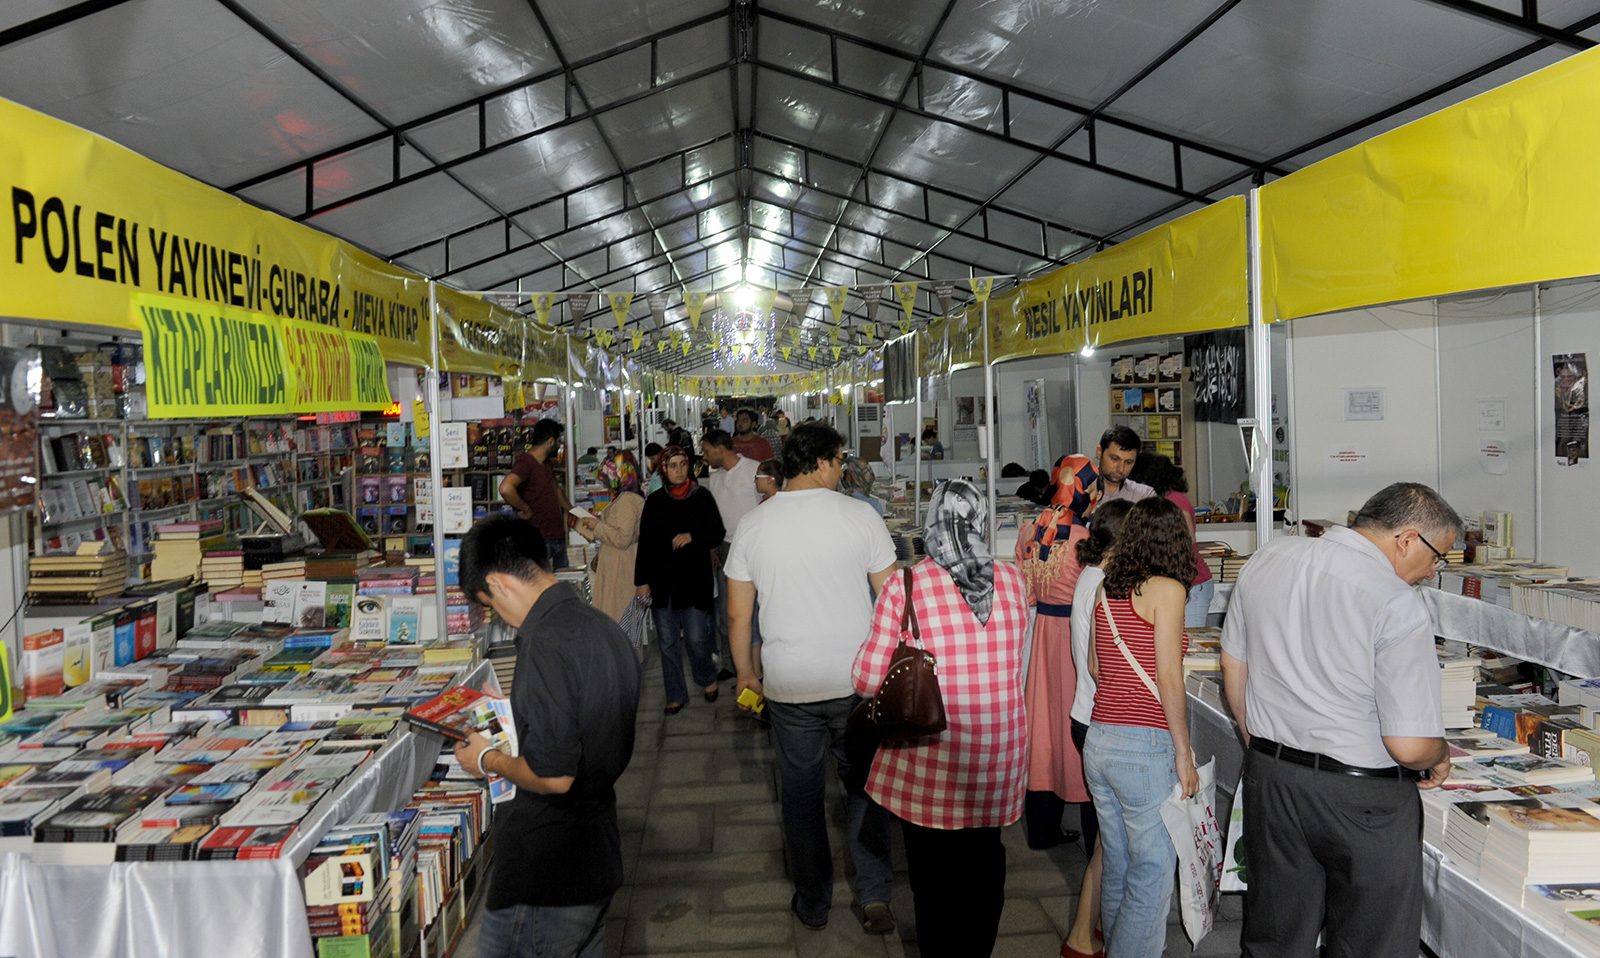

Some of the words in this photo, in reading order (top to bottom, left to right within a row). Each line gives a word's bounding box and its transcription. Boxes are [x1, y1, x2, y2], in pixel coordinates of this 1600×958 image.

[11, 186, 140, 287] POLEN
[352, 290, 386, 338] MEVA
[389, 292, 419, 343] KİTAP
[1024, 291, 1061, 340] NESİL
[1063, 268, 1154, 330] YAYINLARI
[140, 306, 286, 405] KİTAPLARIMIZDA
[310, 330, 352, 401] İNDİRİM
[350, 338, 390, 402] VARDIR
[1196, 882, 1204, 900] TOEFL
